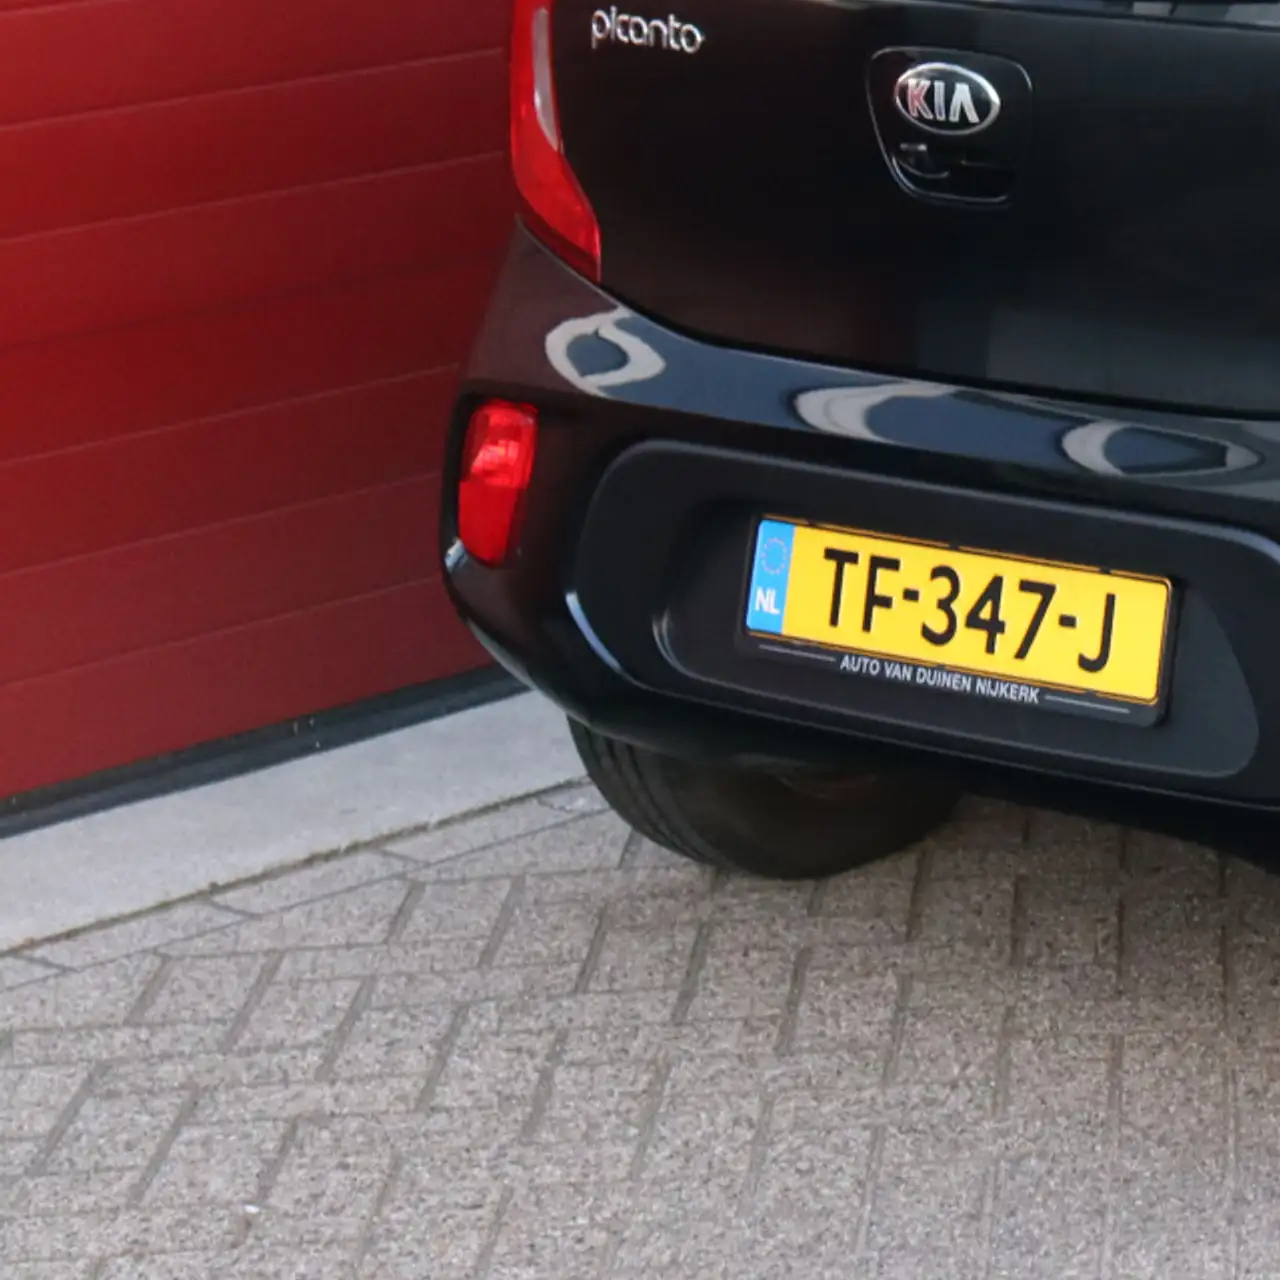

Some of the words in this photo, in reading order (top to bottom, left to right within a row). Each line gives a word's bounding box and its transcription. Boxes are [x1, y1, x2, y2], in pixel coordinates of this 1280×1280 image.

[591, 5, 705, 54] picanto
[906, 77, 981, 124] KIA
[754, 585, 781, 616] NL
[823, 546, 1117, 674] TF-347-J
[839, 654, 881, 677] AUTO
[884, 660, 914, 682] VAN
[916, 667, 972, 693] DUINEN
[976, 678, 1040, 705] NIJKERK
